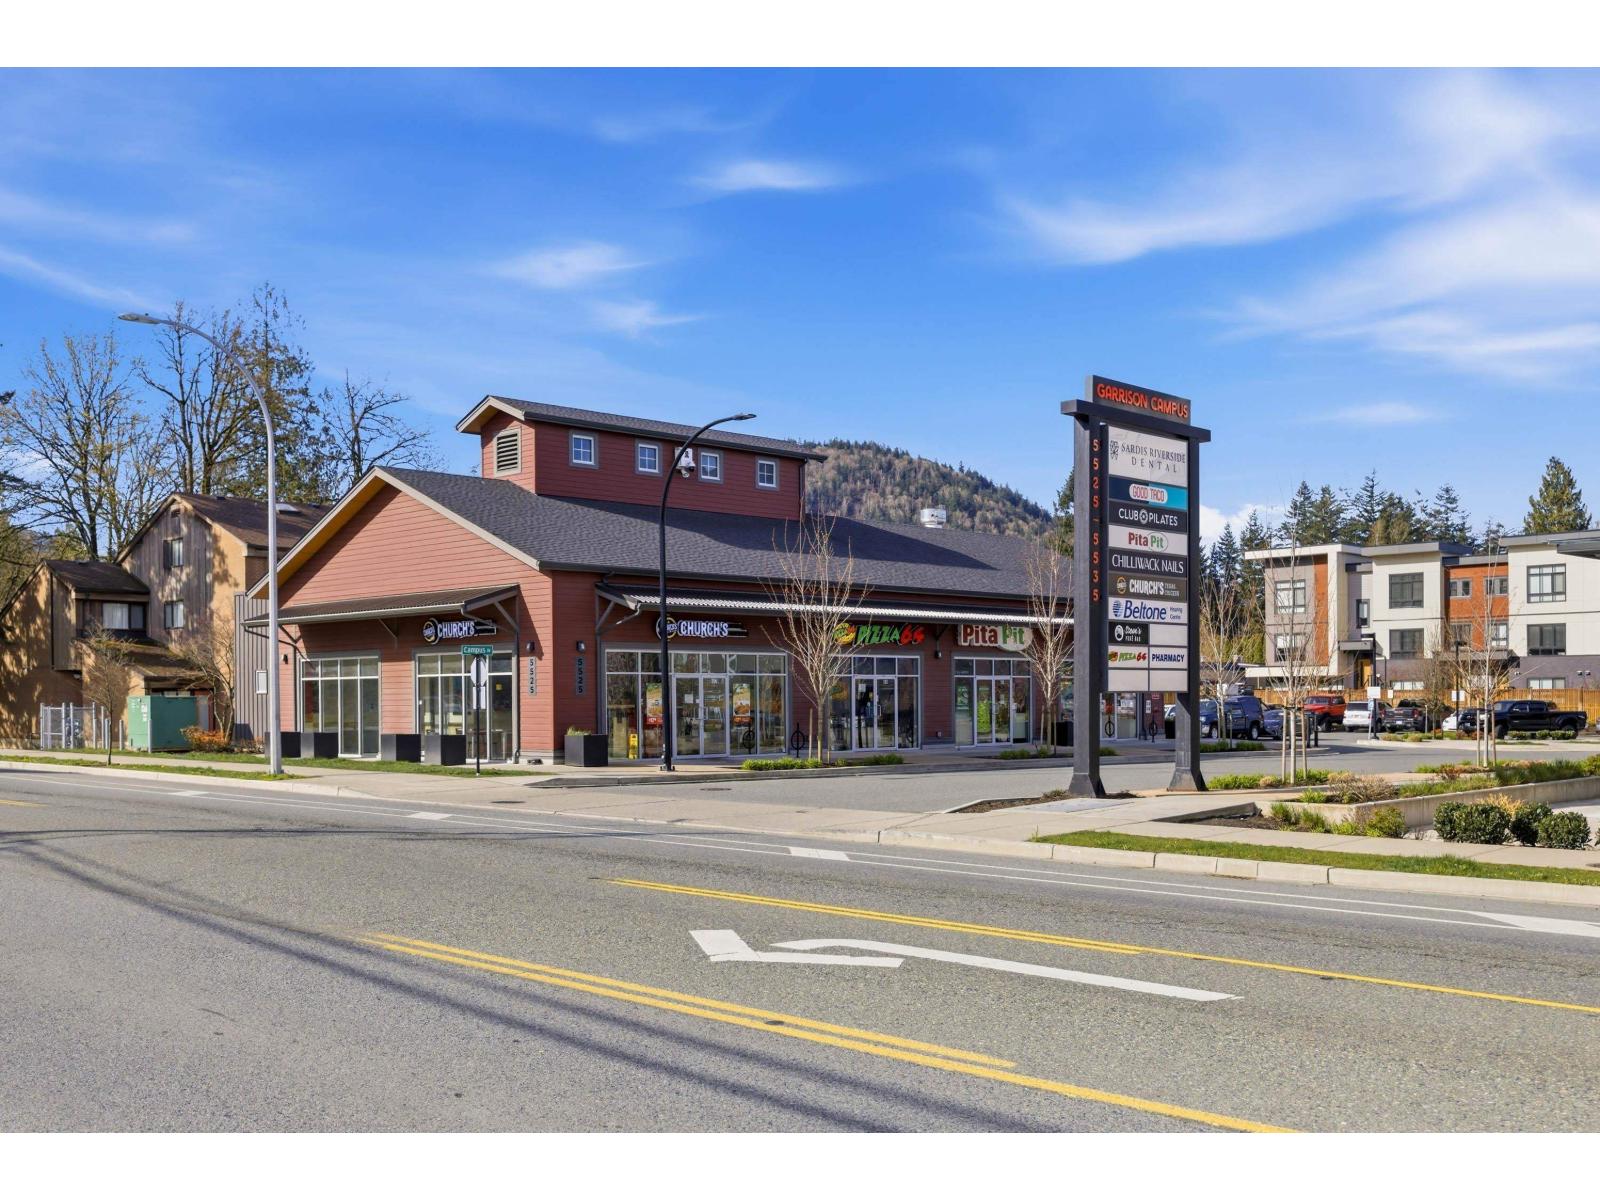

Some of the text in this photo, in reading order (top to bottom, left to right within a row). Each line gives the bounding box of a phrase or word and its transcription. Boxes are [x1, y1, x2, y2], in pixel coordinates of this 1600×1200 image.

[1097, 384, 1189, 418] GARRISON CAMPUS
[1121, 442, 1186, 464] SARDIS RIVERSIDE
[1132, 458, 1177, 473] DENTAL
[1132, 485, 1164, 502] GOOD TACO
[1118, 508, 1178, 526] CLUB PILATES
[1128, 532, 1164, 548] Pita Pit
[1112, 554, 1184, 574] CHILLIWACK NAILS
[1129, 579, 1164, 595] CHURCH'S
[1124, 600, 1166, 620] Beltone
[438, 621, 475, 638] CHURCH'S
[680, 621, 728, 637] CHURCH'S
[856, 625, 900, 645] PIZZA
[961, 625, 1025, 645] Pita Pit
[1152, 654, 1185, 662] PHARMACY
